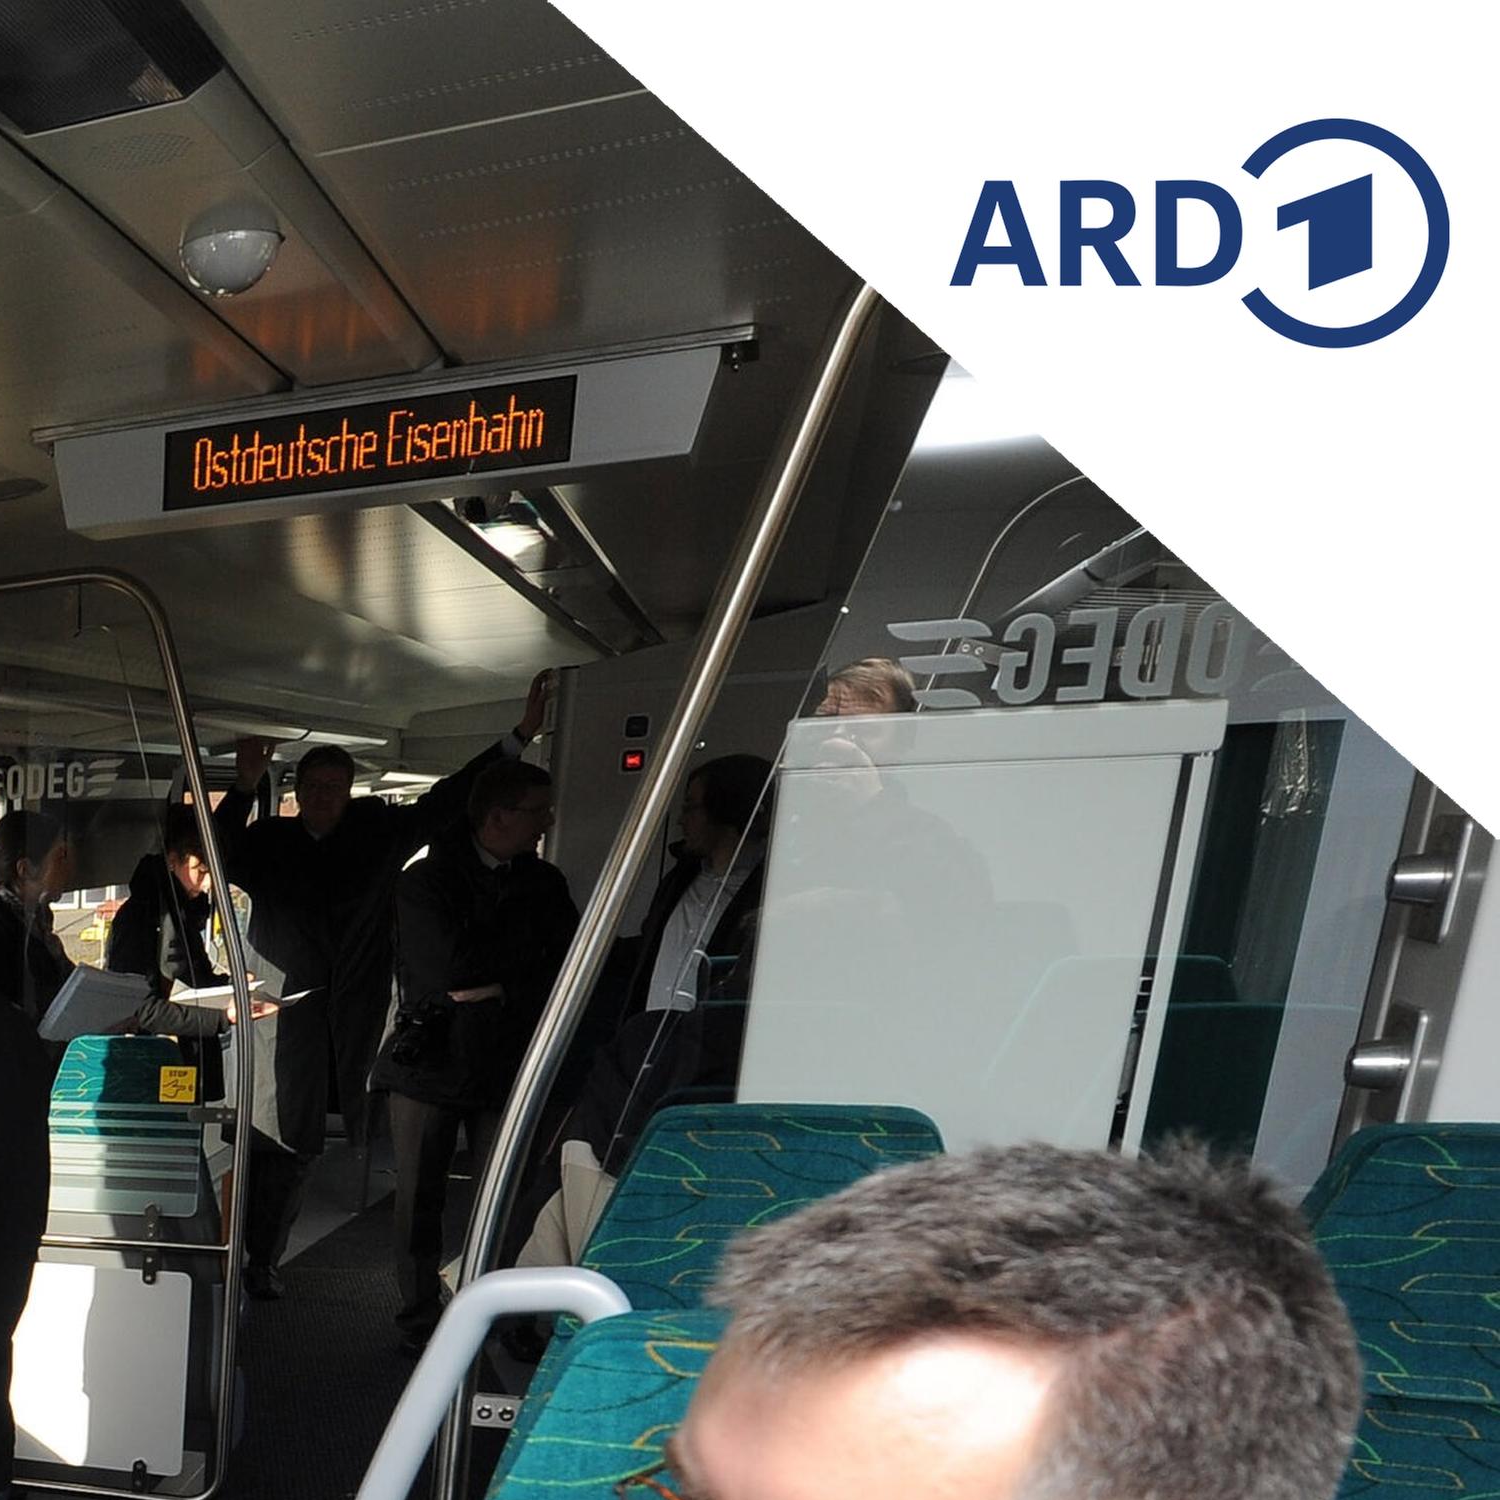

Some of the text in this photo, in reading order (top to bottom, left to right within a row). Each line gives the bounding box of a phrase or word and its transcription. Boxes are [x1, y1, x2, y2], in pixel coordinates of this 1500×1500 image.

[193, 394, 545, 491] Ostdeutsche Eisenbahn
[6, 761, 85, 801] ODEG
